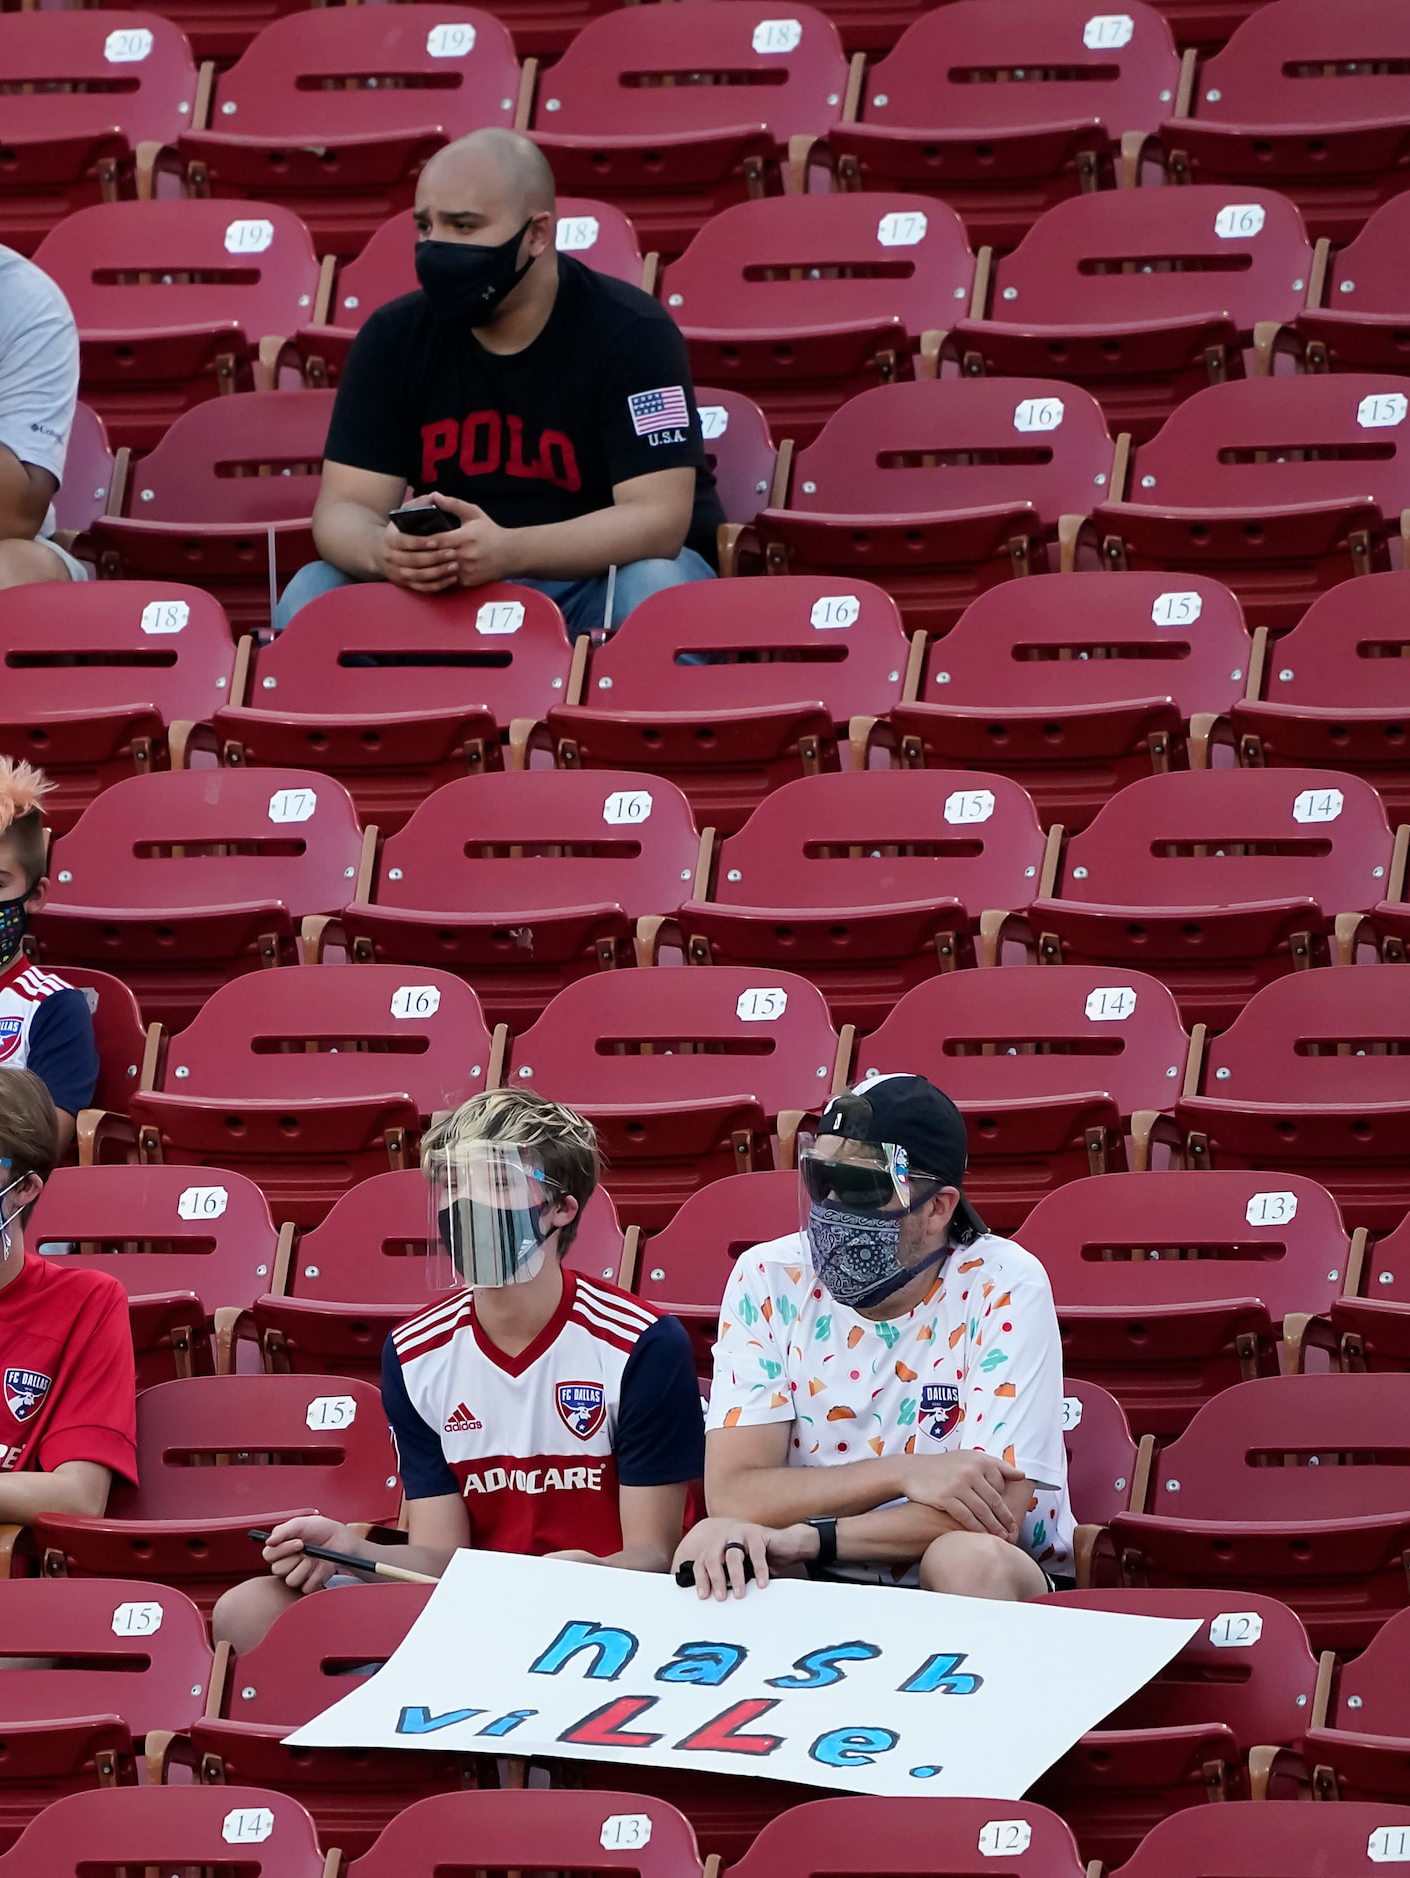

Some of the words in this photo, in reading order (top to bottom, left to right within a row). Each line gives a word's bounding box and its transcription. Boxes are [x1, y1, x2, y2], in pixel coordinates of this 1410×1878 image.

[440, 29, 466, 51] 19
[766, 25, 791, 47] 18
[1097, 20, 1123, 43] 17
[115, 35, 143, 56] 20
[891, 217, 917, 240] 17
[1229, 210, 1254, 232] 16
[238, 226, 263, 247] 19
[563, 223, 588, 245] 18
[1027, 404, 1052, 426] 16
[1372, 398, 1397, 421] 15
[420, 409, 582, 492] POLO
[154, 606, 179, 628] 18
[489, 606, 515, 628] 17
[825, 601, 849, 623] 16
[1166, 597, 1191, 619] 15
[282, 793, 307, 817] 17
[617, 797, 641, 818] 16
[959, 795, 984, 818] 15
[1307, 794, 1333, 817] 14
[405, 992, 429, 1013] 16
[751, 993, 777, 1015] 15
[1100, 992, 1125, 1015] 14
[192, 1191, 217, 1214] 16
[1260, 1197, 1285, 1220] 13
[8, 1371, 19, 1384] FC
[22, 1374, 49, 1391] DALLAS
[562, 1389, 572, 1401] FC
[574, 1389, 601, 1403] DALLAS
[926, 1386, 958, 1401] DALLAS
[320, 1401, 346, 1424] 15
[444, 1420, 483, 1433] adidas
[126, 1607, 152, 1630] 15
[1224, 1618, 1250, 1641] 12
[528, 1620, 985, 1696] nash
[237, 1813, 262, 1837] 14
[615, 1819, 640, 1843] 13
[994, 1825, 1019, 1849] 12
[1383, 1832, 1406, 1856] 11
